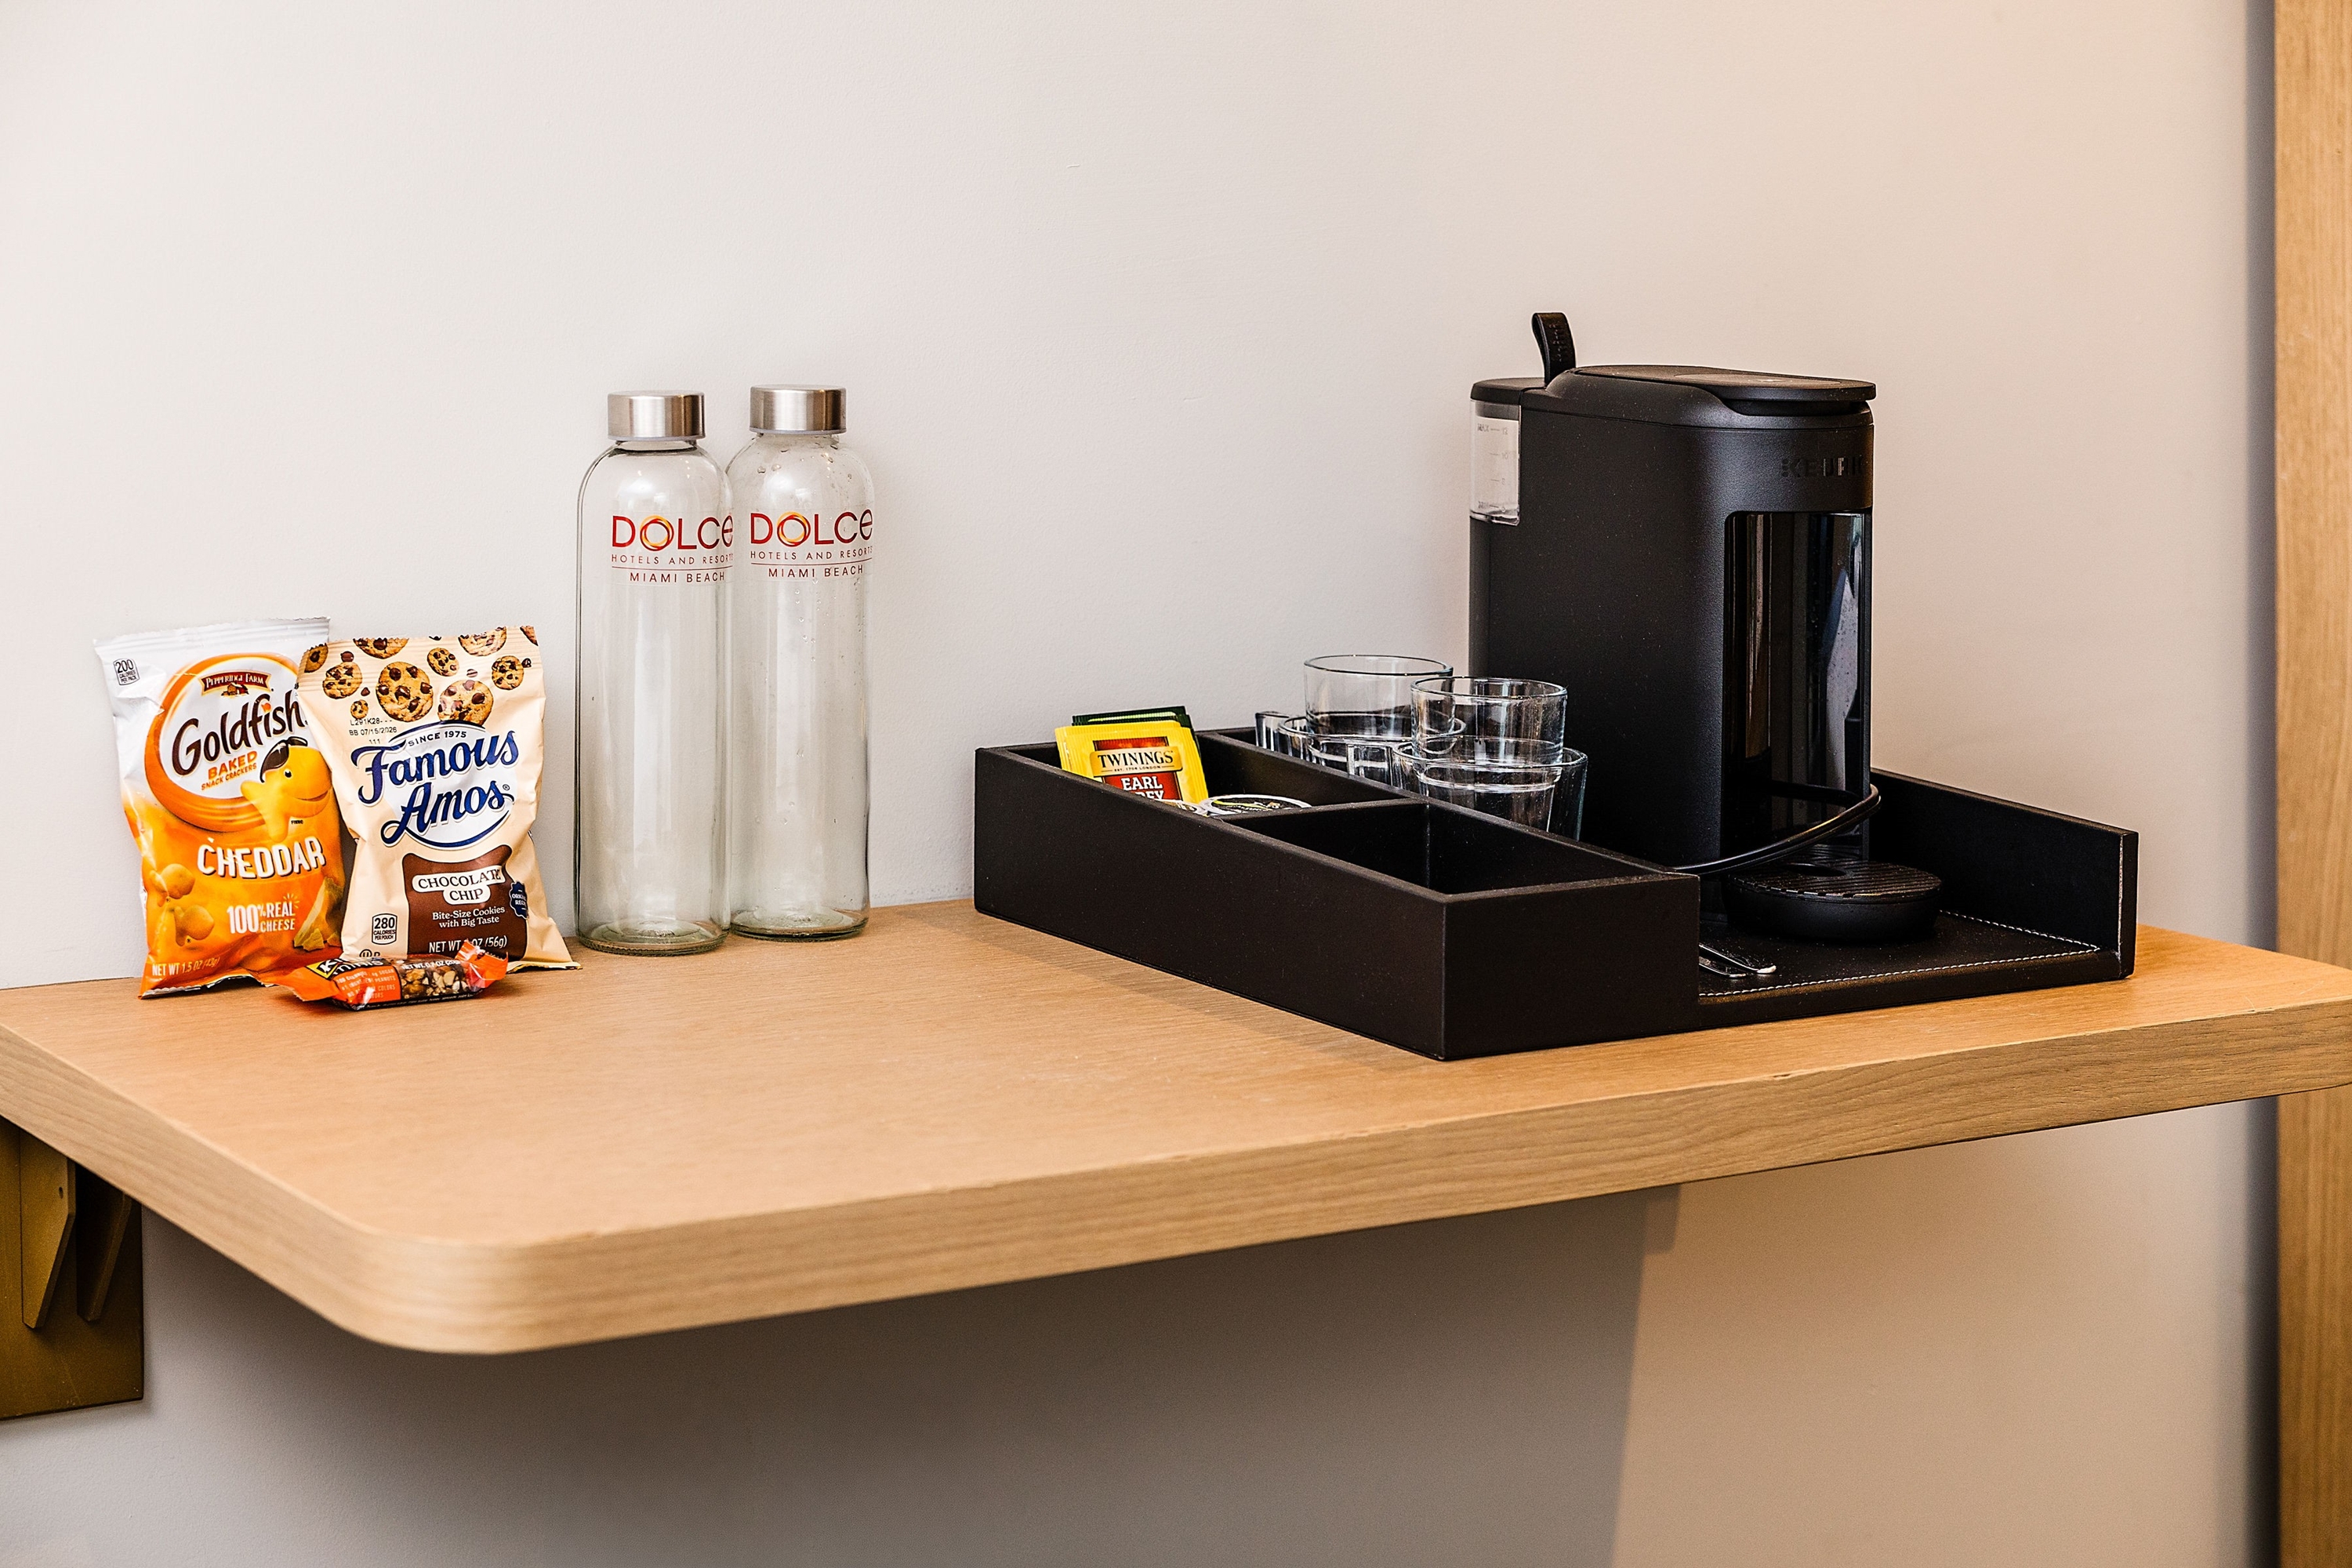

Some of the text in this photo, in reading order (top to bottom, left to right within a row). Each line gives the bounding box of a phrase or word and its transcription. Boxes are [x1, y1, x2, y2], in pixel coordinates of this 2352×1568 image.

[612, 554, 659, 564] HOTELS
[750, 550, 797, 560] HOTELS
[630, 572, 724, 583] MIAMI BEACH
[768, 564, 864, 578] MIAMI BEACH
[114, 659, 134, 674] 200
[245, 673, 265, 685] FARM
[172, 689, 306, 776] Goldfish
[360, 727, 397, 736] 07/15/2026
[408, 731, 441, 747] SINCE
[208, 750, 258, 779] BAKED
[350, 730, 519, 804] Famous
[1098, 750, 1174, 768] TWININGS
[201, 763, 257, 791] SNACK CRACKERS
[1120, 775, 1163, 791] EARL
[381, 780, 506, 847] Amos
[197, 836, 328, 879] CHEDDAR
[418, 869, 502, 889] CHOCOLATE
[449, 888, 484, 901] CHIP
[227, 901, 296, 934] 100% REAL
[432, 906, 506, 920] Bite-Size Cookies
[260, 918, 296, 933] CHEESE
[374, 916, 395, 929] 280
[438, 916, 500, 928] with Big Taste
[429, 941, 447, 953] NET
[448, 940, 462, 952] WT
[485, 935, 508, 949] (56g)
[152, 962, 167, 976] NET
[168, 962, 180, 975] WT
[181, 961, 193, 974] 1.5
[193, 960, 204, 971] OZ
